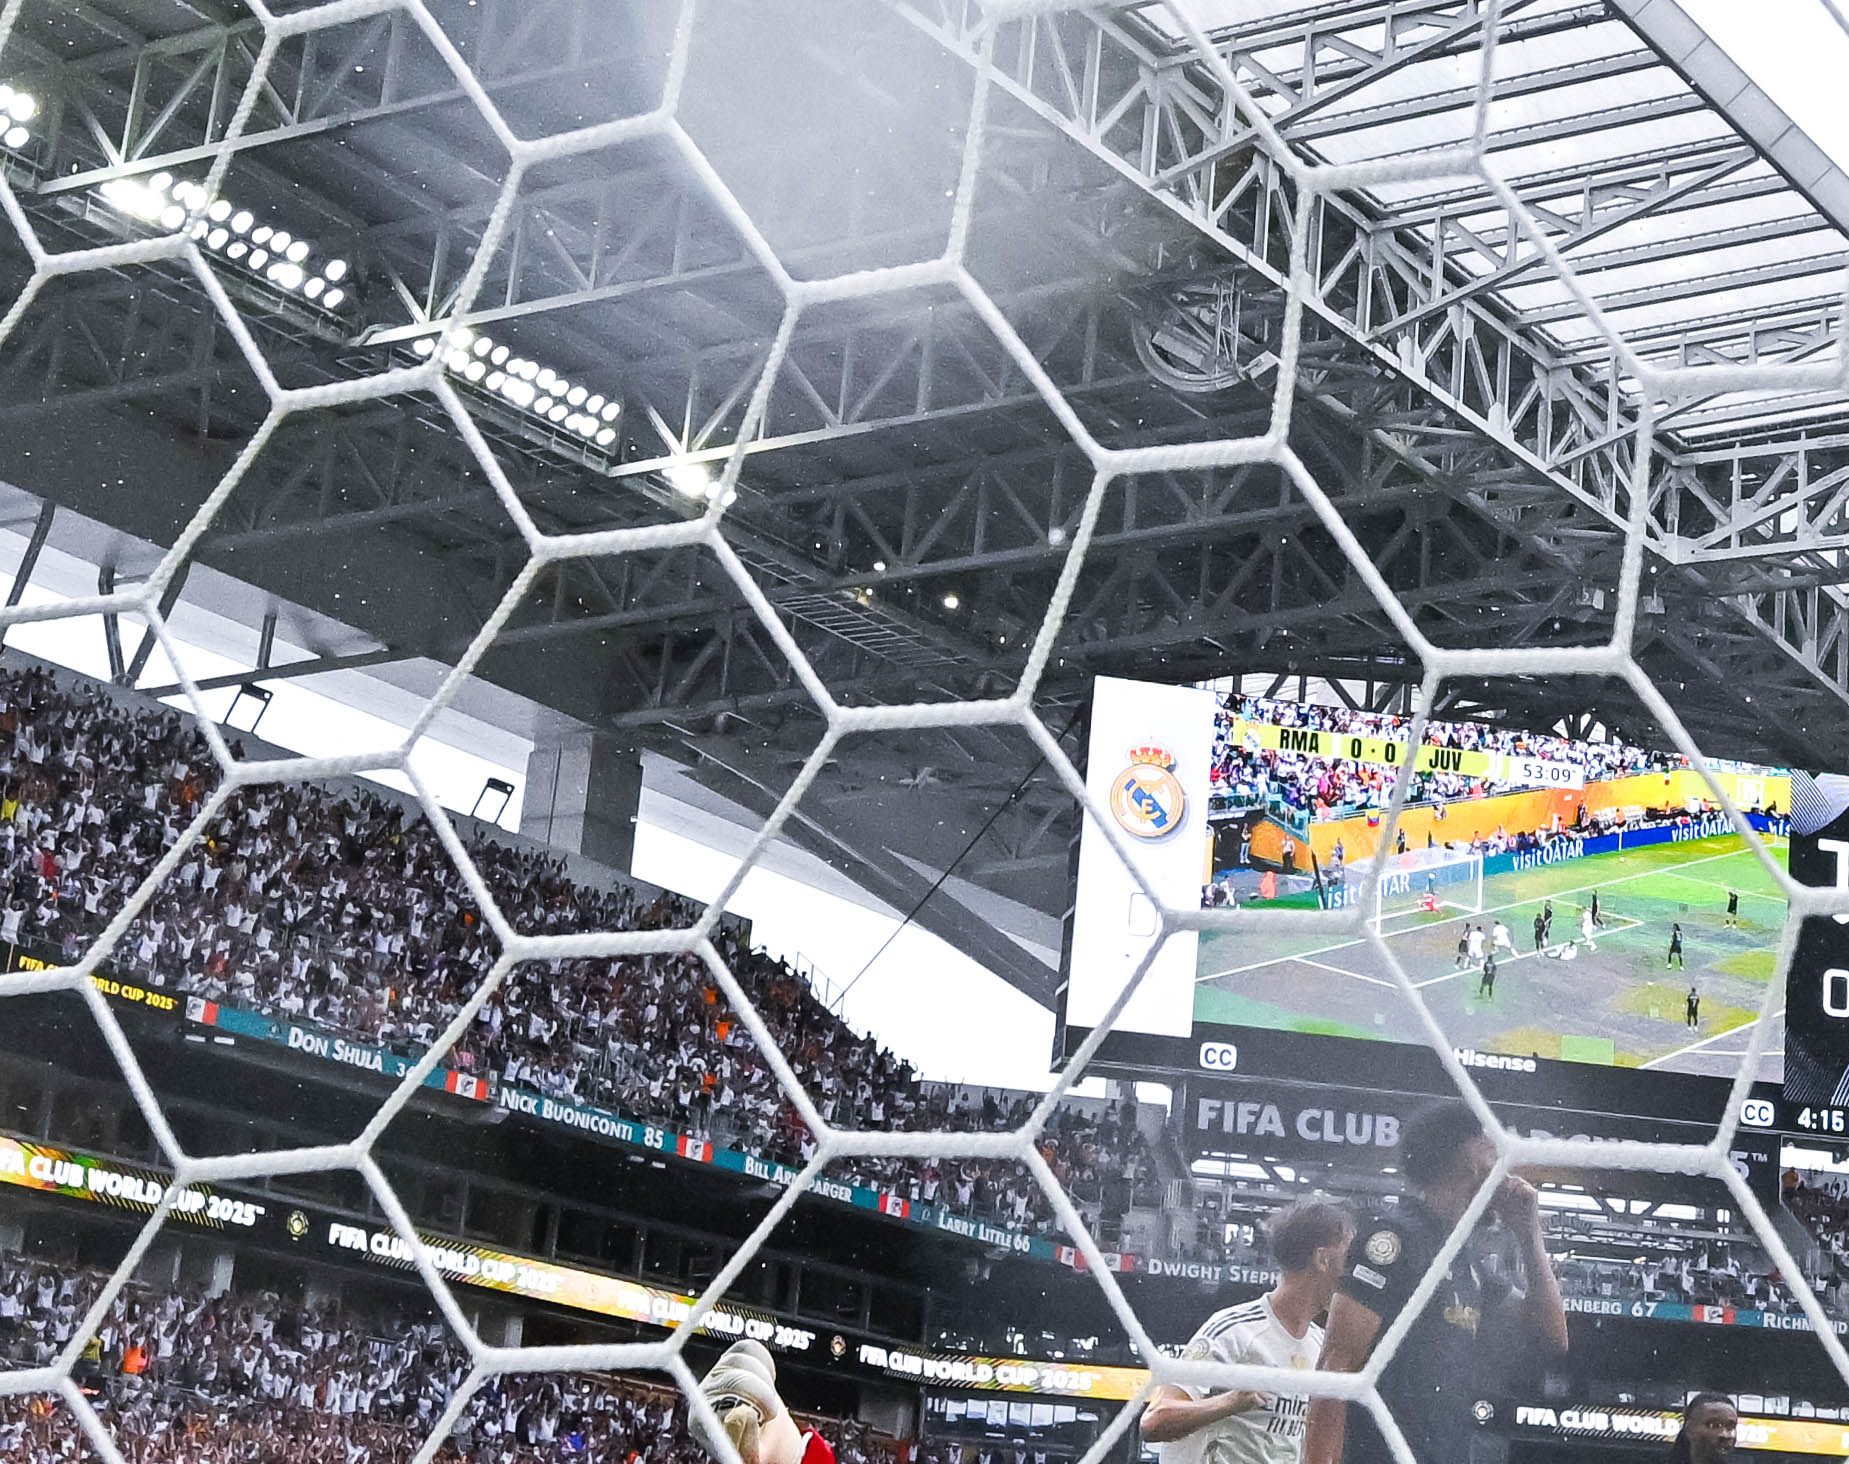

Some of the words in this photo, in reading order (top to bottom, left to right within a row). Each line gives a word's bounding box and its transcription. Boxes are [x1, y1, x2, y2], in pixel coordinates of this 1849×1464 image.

[1279, 728, 1319, 754] RMA
[1350, 738, 1363, 759] 0
[1384, 742, 1396, 764] 0
[1428, 748, 1463, 772] JUV
[1522, 762, 1572, 783] 53:09
[1511, 837, 1585, 871] visitQATAR
[121, 984, 145, 1002] CUP
[1203, 1047, 1233, 1067] CC
[1452, 1047, 1537, 1073] Hisense
[1198, 1098, 1286, 1138] FIFA
[1296, 1108, 1402, 1148] CLUB
[1743, 1104, 1771, 1123] CC
[1797, 1108, 1846, 1134] 4:15
[643, 1124, 665, 1149] 85
[29, 1154, 85, 1190] CLUB
[88, 1167, 162, 1204] WORLD
[328, 1222, 367, 1252] FIFA
[481, 1258, 516, 1283] CUP
[1013, 1233, 1031, 1253] 66
[1630, 1300, 1658, 1319] 67
[745, 1318, 775, 1342] CUP
[1763, 1312, 1848, 1338] RICHMND
[859, 1344, 888, 1368] FIFA
[888, 1351, 922, 1377] CLUB
[923, 1357, 991, 1384] WORLD
[996, 1364, 1040, 1388] CUP
[1515, 1406, 1558, 1428] FIFA
[1560, 1409, 1609, 1432] CLUB
[1610, 1412, 1682, 1438] WORLD
